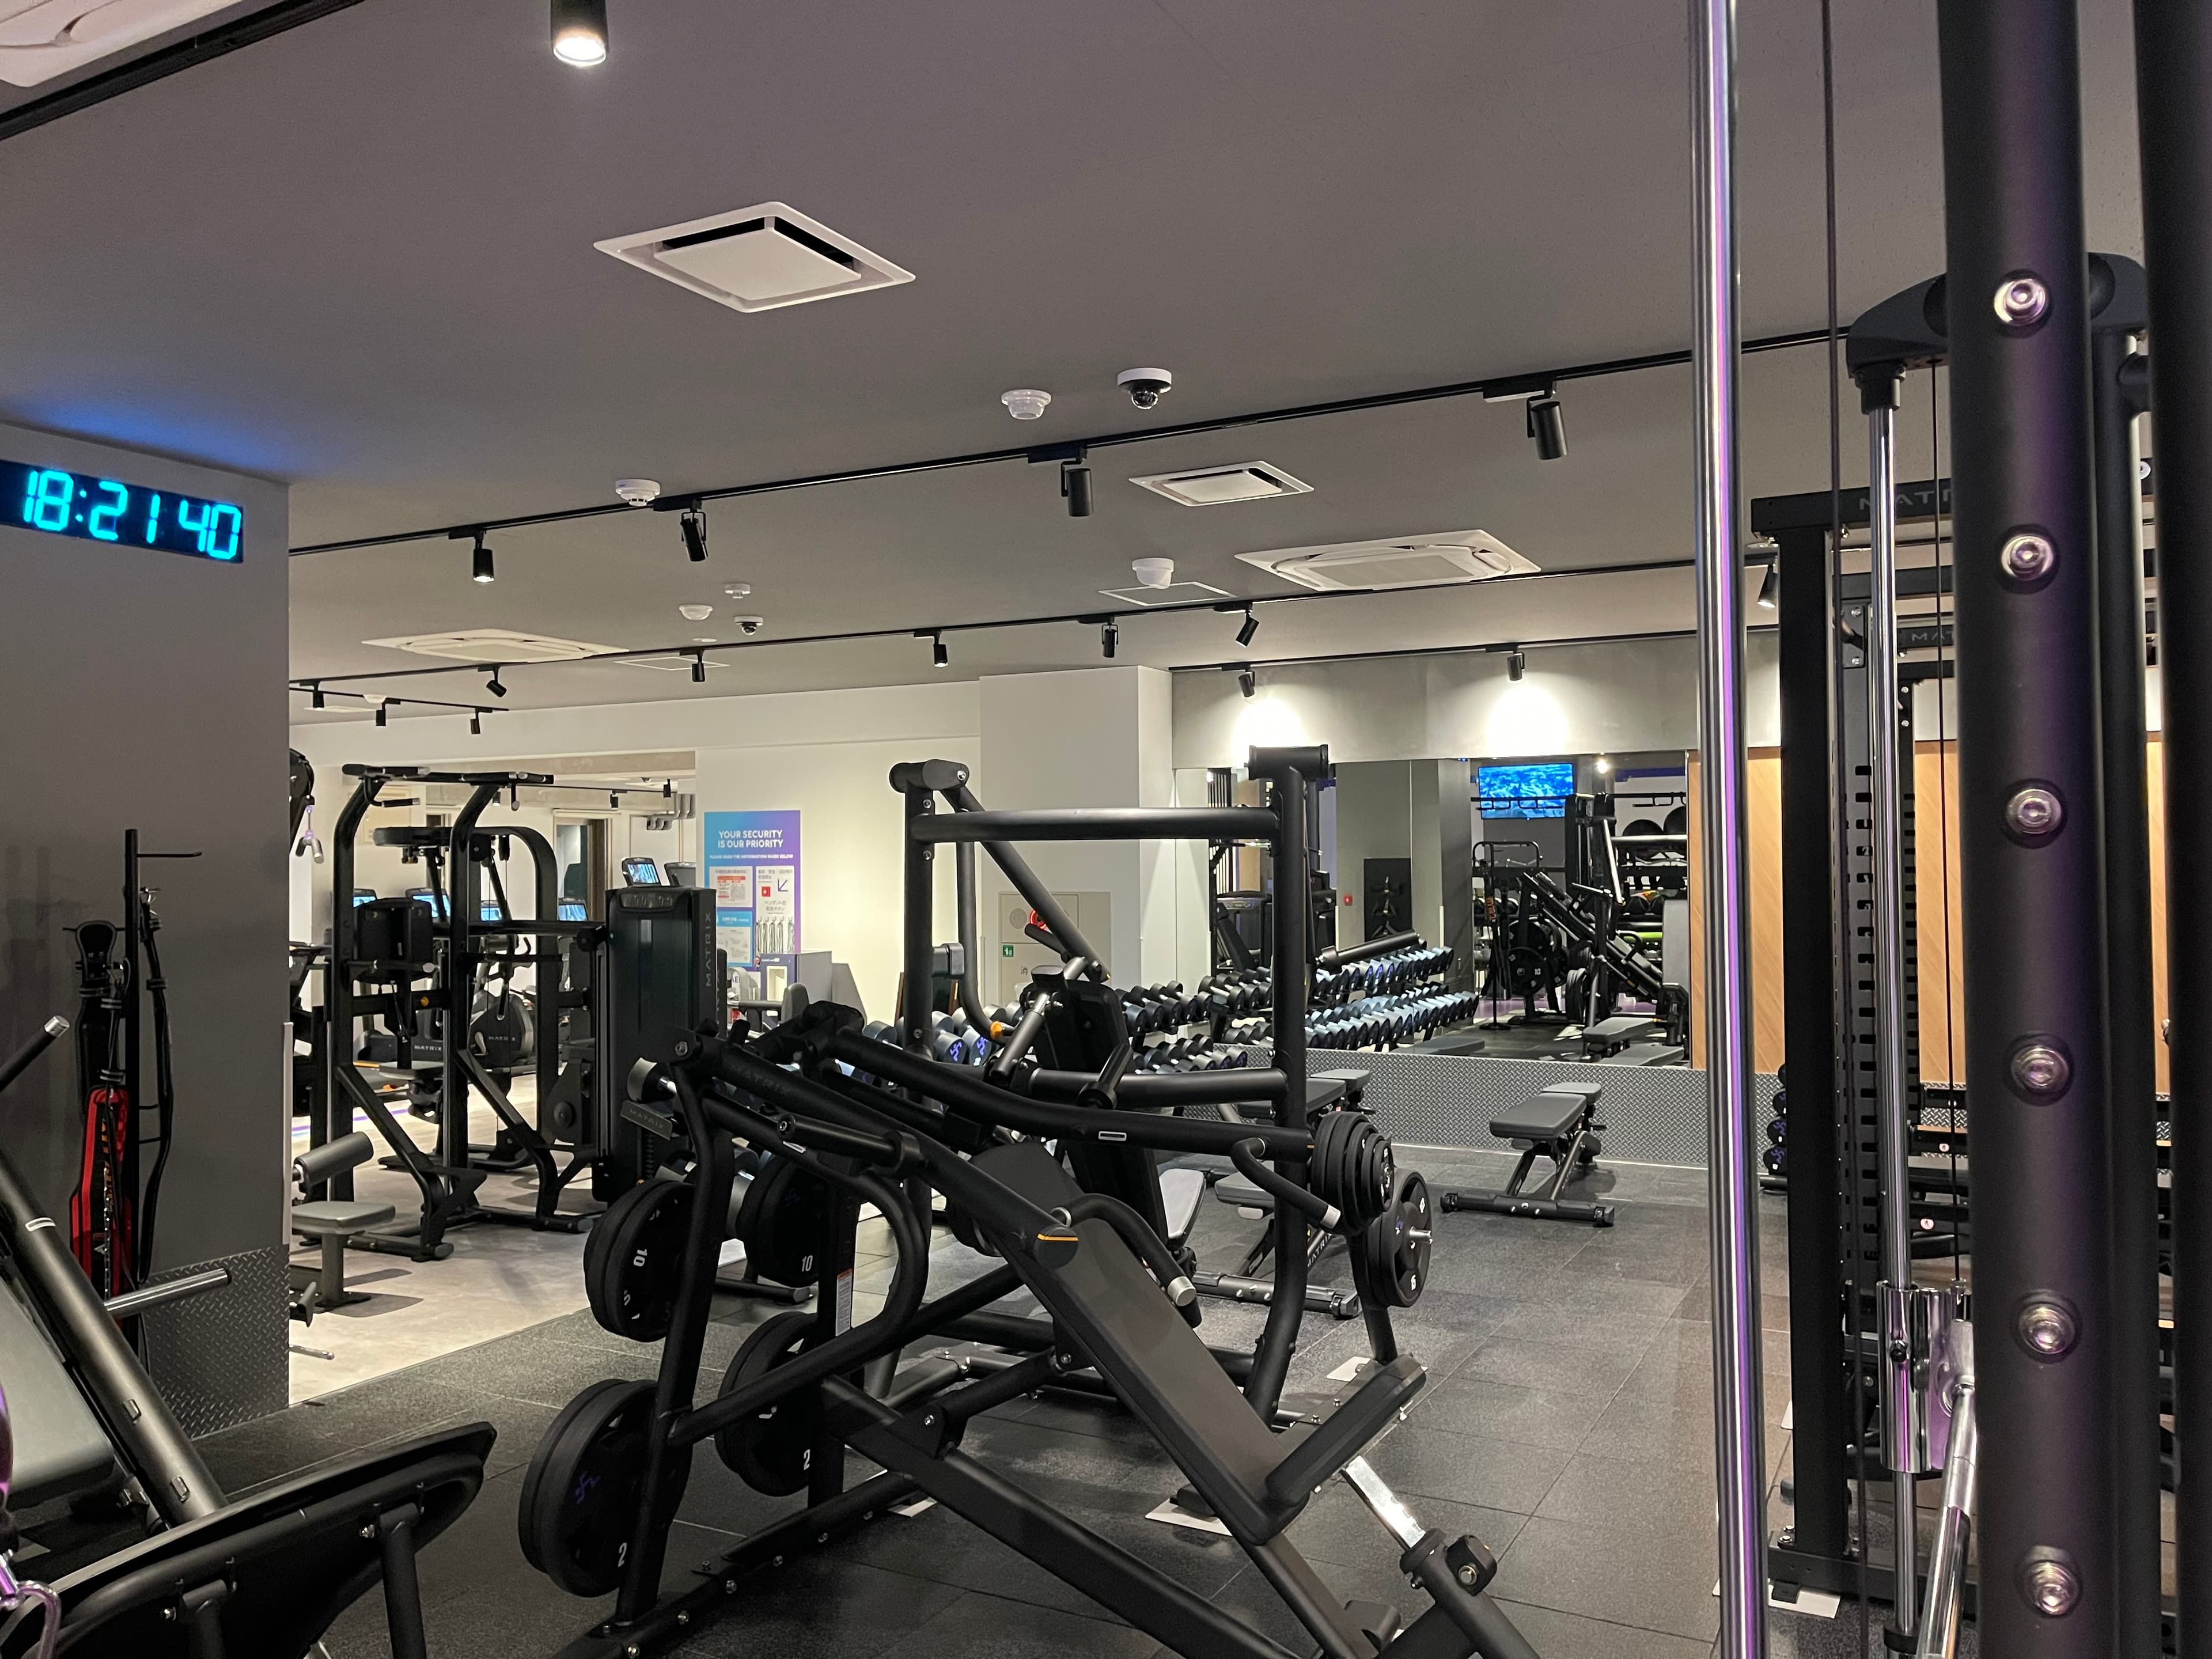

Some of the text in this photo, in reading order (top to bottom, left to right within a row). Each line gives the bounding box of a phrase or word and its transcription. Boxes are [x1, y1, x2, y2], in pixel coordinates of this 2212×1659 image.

[23, 469, 242, 560] 18:21 40
[719, 830, 782, 839] YOUR SECURITY
[718, 839, 783, 849] IS OUR PRIORITY
[629, 1108, 664, 1129] MATRIX
[633, 1248, 648, 1267] 10
[801, 1255, 813, 1272] 10
